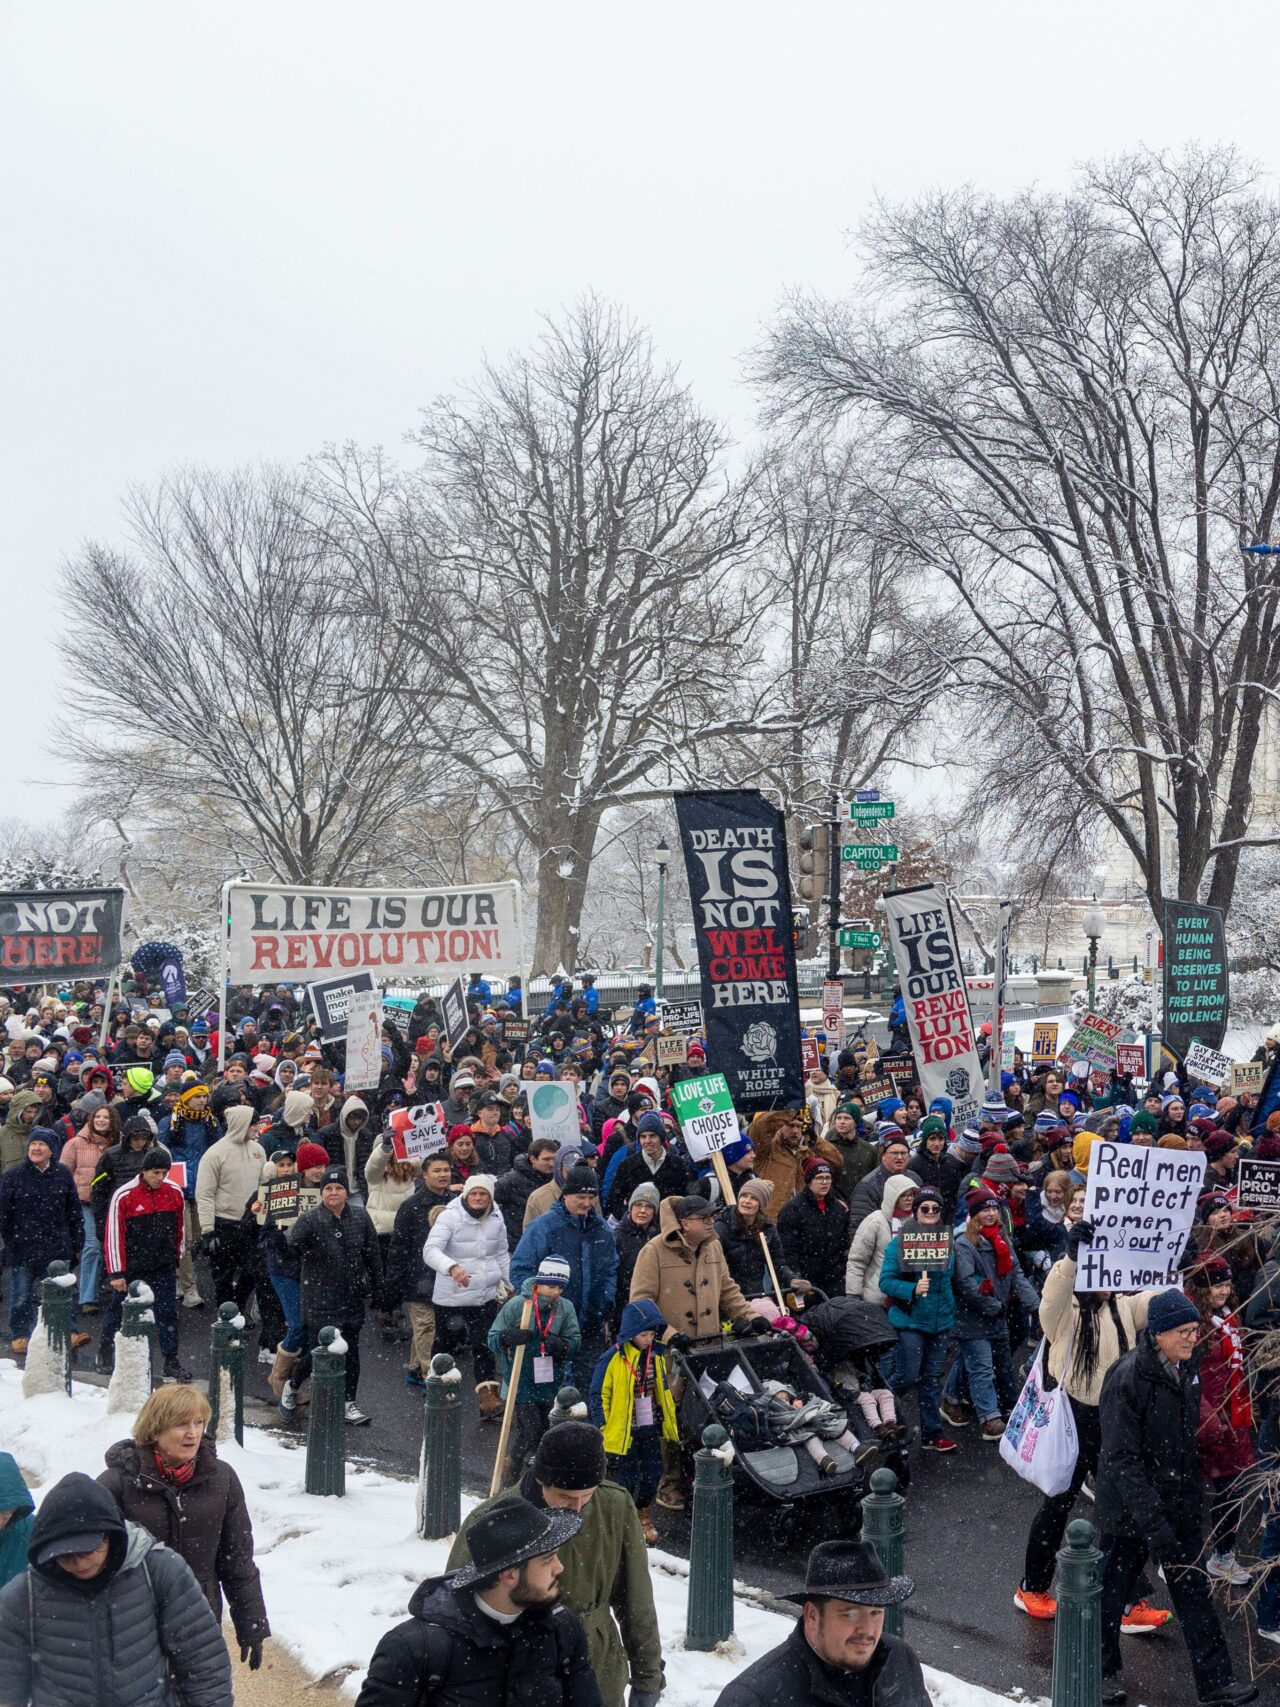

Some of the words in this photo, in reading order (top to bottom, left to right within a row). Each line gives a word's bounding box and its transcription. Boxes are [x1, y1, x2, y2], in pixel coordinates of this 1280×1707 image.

[860, 819, 876, 827] UNIT
[689, 827, 776, 850] DEATH
[843, 847, 886, 859] CAPITOL
[860, 861, 880, 869] 100
[694, 849, 779, 901] IS
[14, 900, 107, 933] NOT
[249, 894, 351, 931] LIFE
[366, 896, 407, 930] IS
[421, 893, 498, 928] OUR
[700, 900, 781, 929] NOT
[894, 909, 946, 938] LIFE
[1177, 918, 1209, 929] EVERY
[704, 928, 784, 956] WEL
[1175, 933, 1214, 945] HUMAN
[1, 935, 103, 969] HERE!
[249, 929, 503, 970] REVOLUTION!
[900, 929, 955, 978] IS
[1178, 948, 1212, 960] BEING
[709, 956, 787, 982] COME
[1171, 964, 1222, 976] DESERVES
[908, 968, 961, 999] OUR
[1176, 980, 1190, 991] TO
[1193, 979, 1217, 991] LIVE
[325, 988, 354, 1001] make
[711, 981, 791, 1008] HERE!
[1168, 995, 1194, 1008] FREE
[1195, 994, 1226, 1006] FROM
[683, 1005, 697, 1013] THE
[912, 989, 967, 1020] REVO
[663, 1012, 700, 1022] PRO-LIFE
[665, 1018, 700, 1028] GENERATION
[1169, 1010, 1223, 1024] VIOLENCE
[915, 1010, 969, 1042] LUT
[1083, 1013, 1123, 1040] EVERY
[1034, 1029, 1056, 1040] DEFEND
[659, 1040, 683, 1049] LIFE
[1033, 1040, 1056, 1055] LIFE
[1118, 1057, 1143, 1066] HEARTS
[1193, 1045, 1209, 1056] GAY
[1210, 1050, 1236, 1066] RIGHTS
[1193, 1052, 1215, 1065] START
[737, 1067, 786, 1081] WHITE
[892, 1071, 913, 1079] ERE!
[1123, 1065, 1139, 1073] BEAT
[1185, 1059, 1226, 1078] CONCEPTION
[1234, 1066, 1260, 1077] LIFE
[677, 1081, 703, 1102] LOVE
[705, 1076, 727, 1096] LIFE
[744, 1079, 780, 1091] ROSE
[860, 1081, 882, 1092] DEATH
[863, 1090, 894, 1105] HERE!
[691, 1113, 733, 1136] CHOOSE
[954, 1111, 977, 1123] ROSE
[410, 1124, 437, 1141] SAVE
[407, 1144, 422, 1155] BABY
[423, 1137, 446, 1151] HUMANS
[705, 1132, 727, 1151] LIFE
[1096, 1143, 1149, 1181] Real
[1156, 1160, 1201, 1183] men
[1245, 1170, 1250, 1179] I
[1254, 1171, 1276, 1182] AM
[271, 1183, 289, 1193] DEATH
[288, 1180, 298, 1189] IS
[1094, 1181, 1193, 1210] protect
[270, 1196, 297, 1211] HERE!
[1089, 1213, 1172, 1231] women
[903, 1231, 938, 1242] DEATH
[939, 1231, 950, 1241] IS
[1129, 1231, 1164, 1250] out
[1167, 1231, 1185, 1250] of
[903, 1248, 949, 1260] HERE!
[1080, 1254, 1124, 1288] the
[1129, 1257, 1179, 1286] womb
